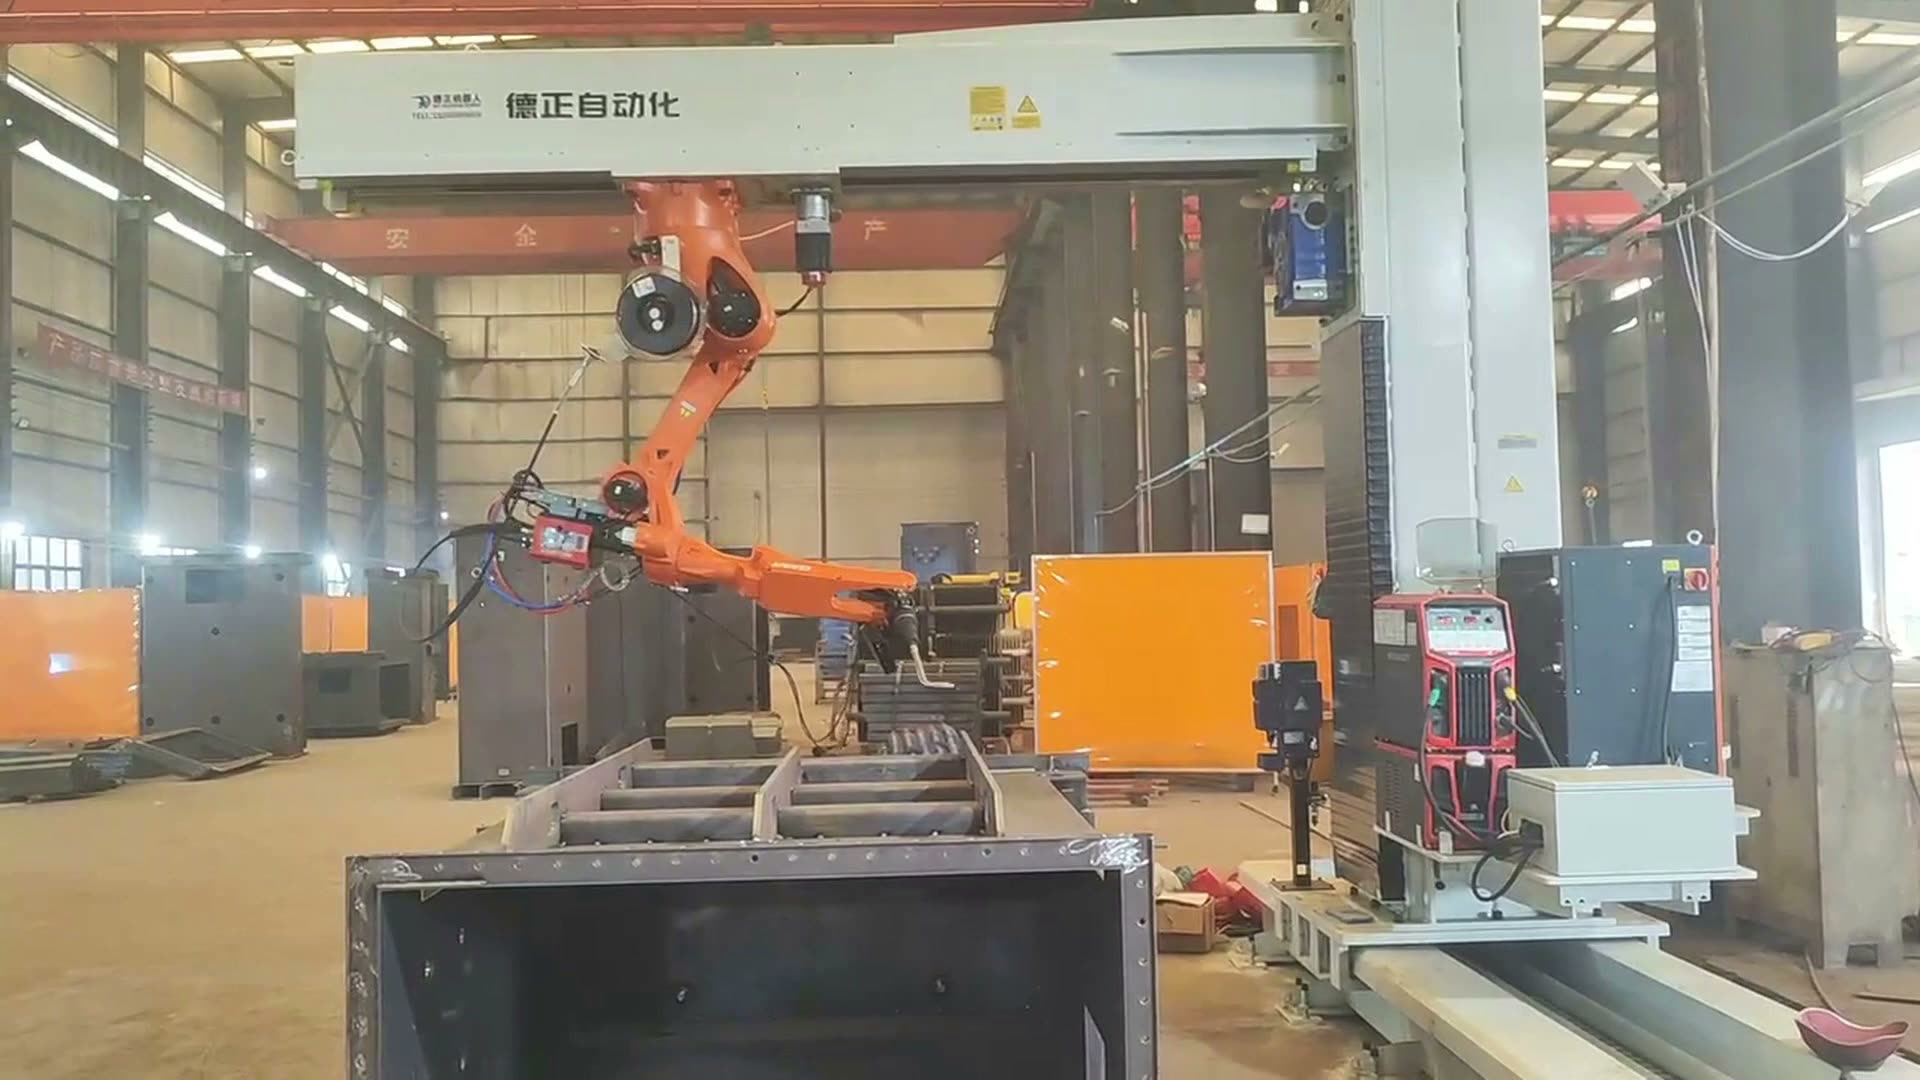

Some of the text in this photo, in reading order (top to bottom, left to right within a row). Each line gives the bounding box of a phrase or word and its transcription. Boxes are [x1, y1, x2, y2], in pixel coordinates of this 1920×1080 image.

[506, 91, 680, 119] 德正自动化
